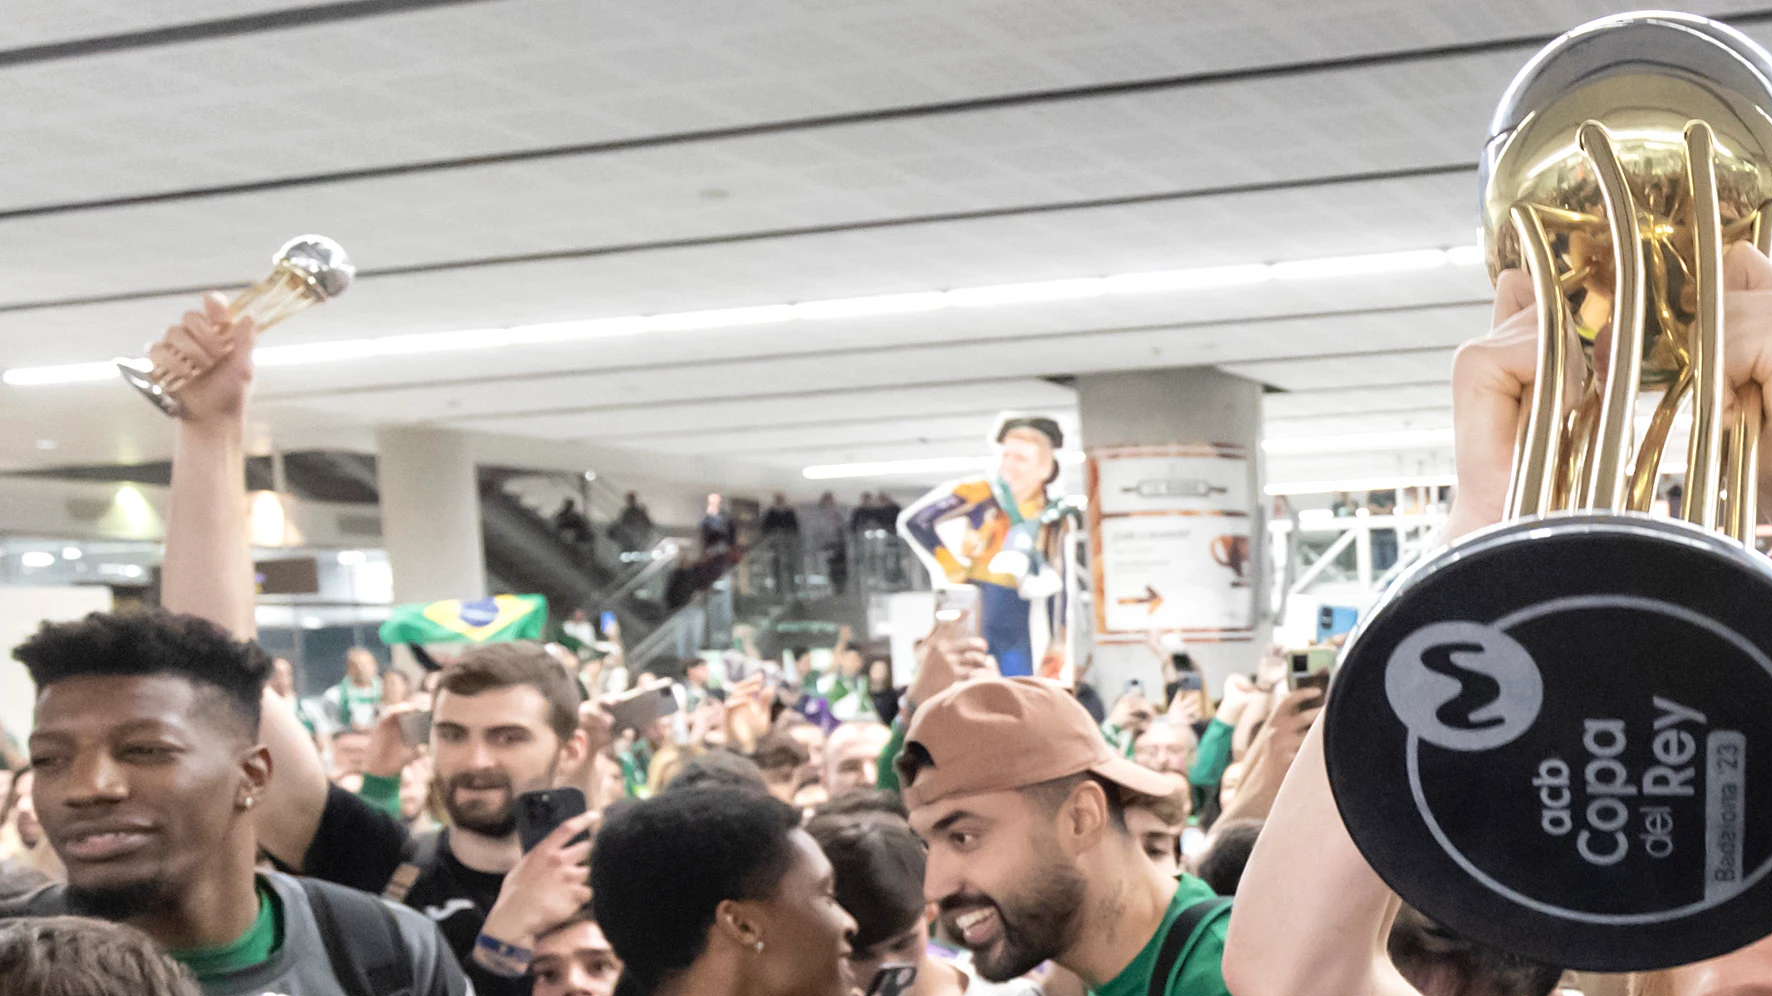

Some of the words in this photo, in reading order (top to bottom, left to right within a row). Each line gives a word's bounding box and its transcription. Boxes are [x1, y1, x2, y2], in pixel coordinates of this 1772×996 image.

[1642, 695, 1708, 797] Rey
[1531, 757, 1573, 837] acb
[1576, 718, 1639, 866] Copa
[1639, 805, 1674, 858] del
